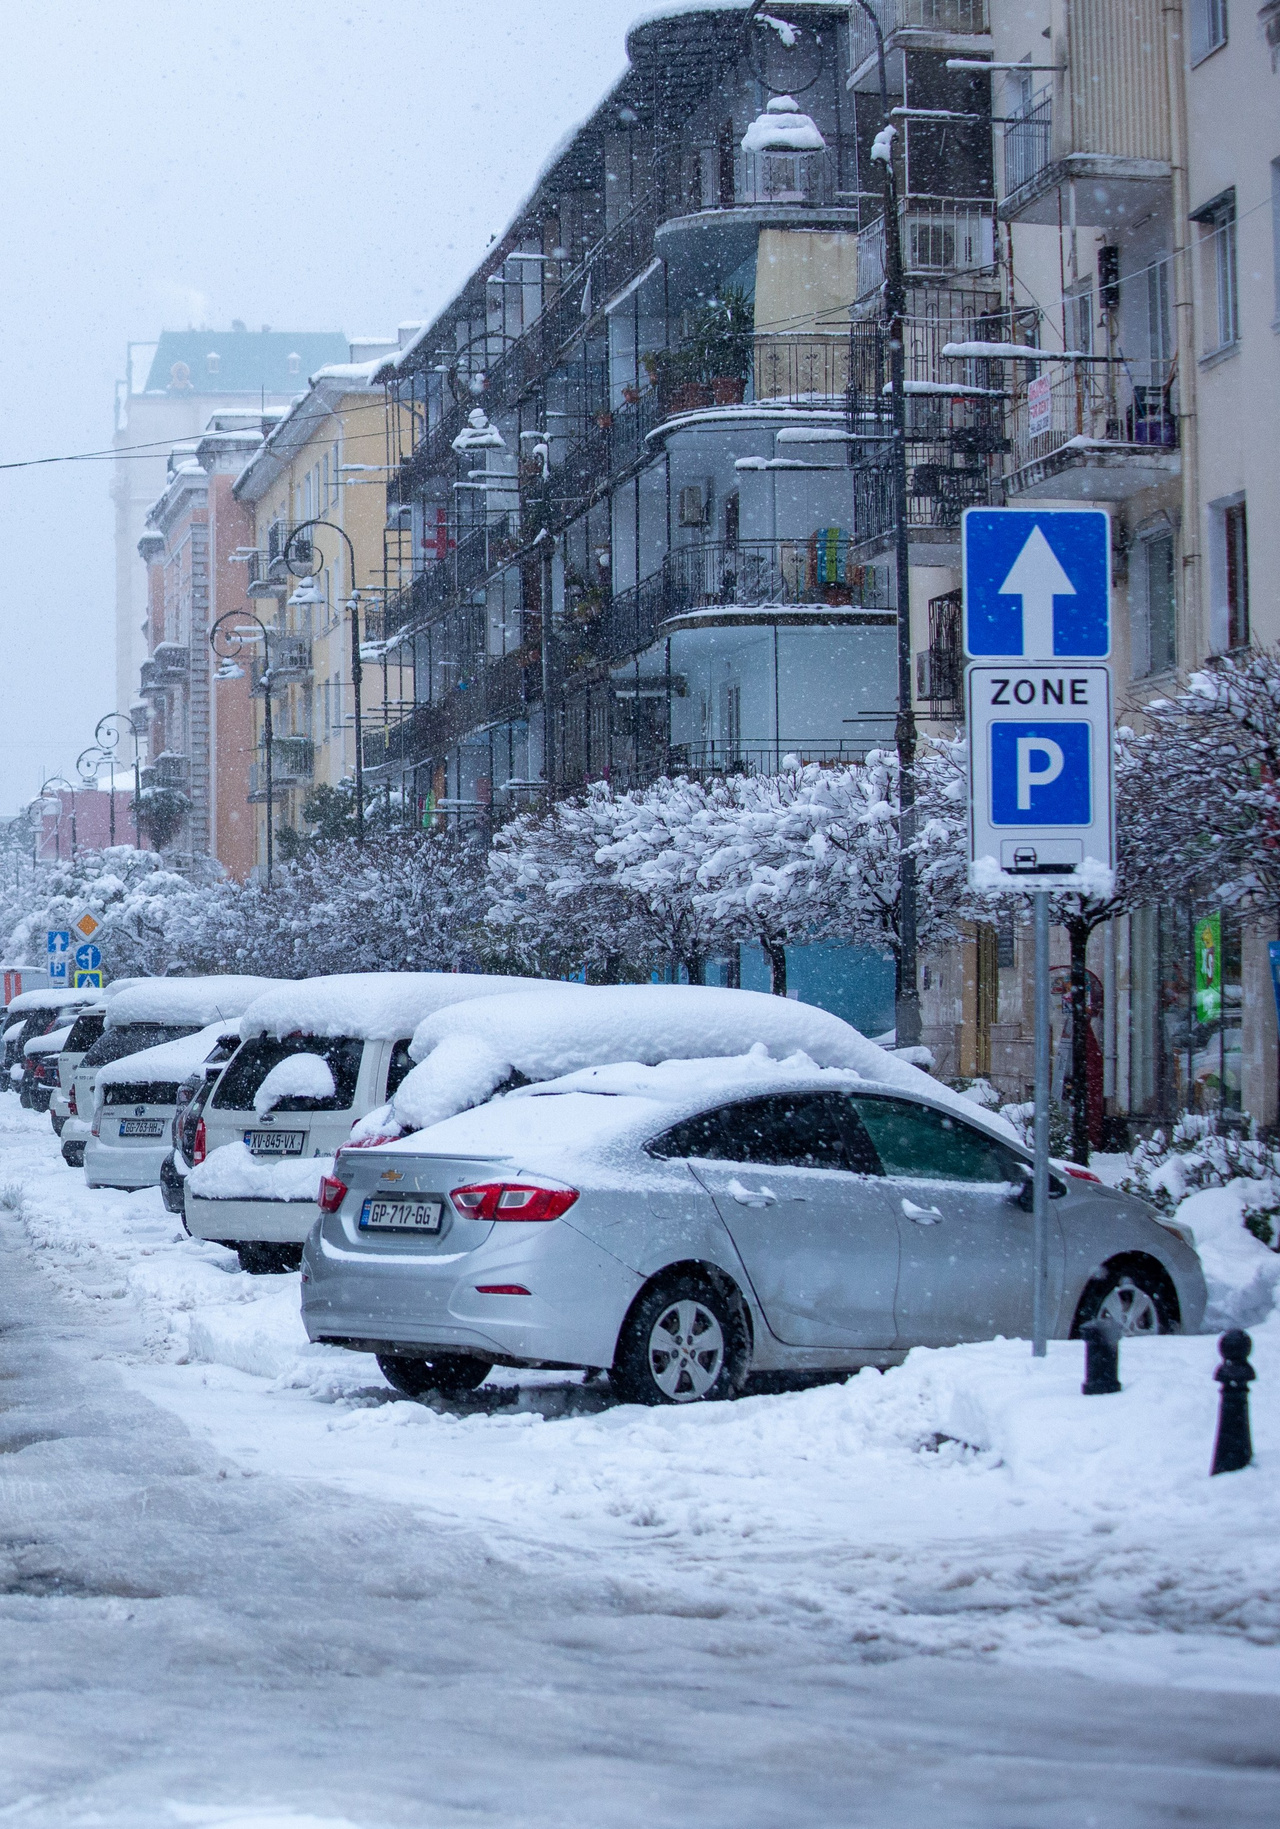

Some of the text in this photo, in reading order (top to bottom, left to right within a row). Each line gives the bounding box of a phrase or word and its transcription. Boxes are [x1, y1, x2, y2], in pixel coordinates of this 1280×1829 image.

[990, 678, 1089, 706] ZONE
[1016, 736, 1064, 811] P
[53, 961, 62, 975] P
[125, 1121, 158, 1133] GG-763-HH
[251, 1133, 296, 1149] XV-845-VX
[371, 1204, 431, 1225] GP-717-GG
